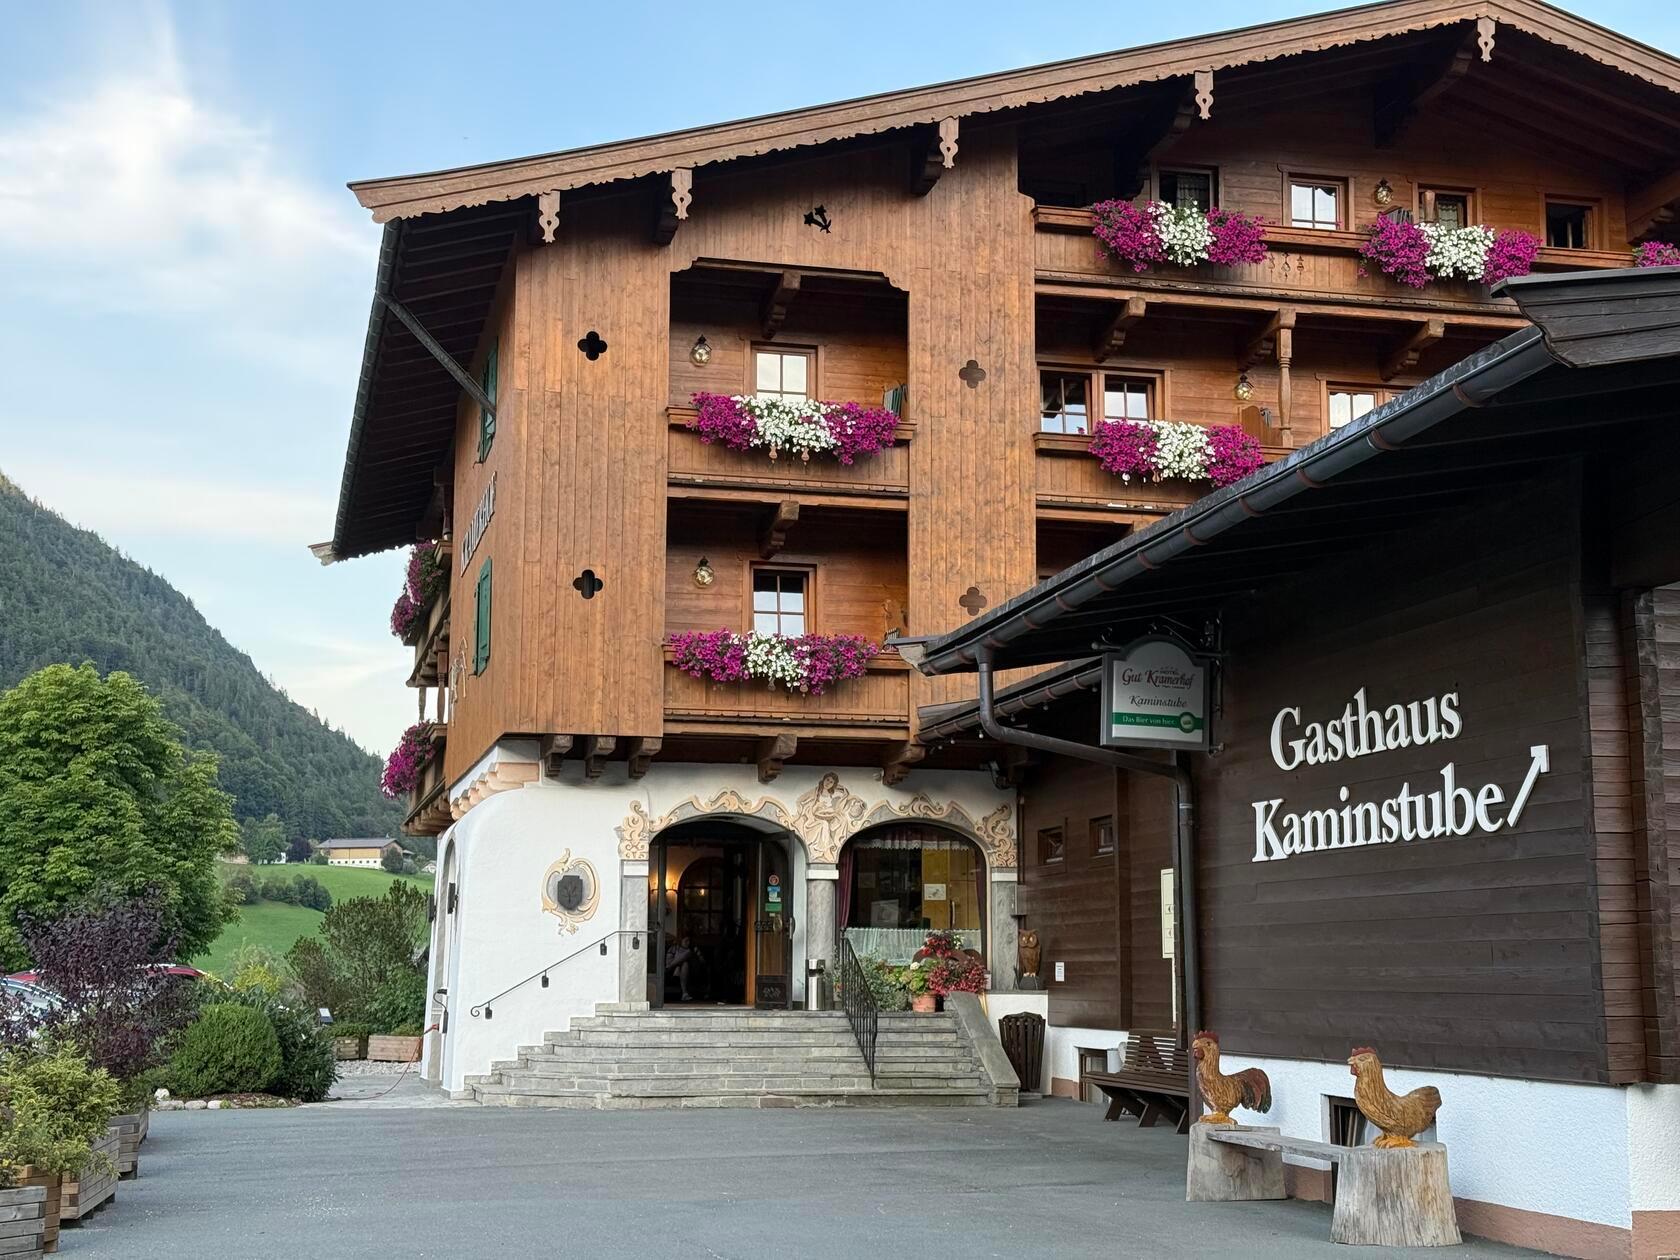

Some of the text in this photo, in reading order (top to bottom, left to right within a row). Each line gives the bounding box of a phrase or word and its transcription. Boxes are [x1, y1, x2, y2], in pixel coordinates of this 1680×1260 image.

[1122, 668, 1195, 690] Gut Kramerhof
[1129, 695, 1187, 708] Kaminstube
[1270, 686, 1463, 771] Gasthaus
[1251, 762, 1506, 863] Kaminstube
